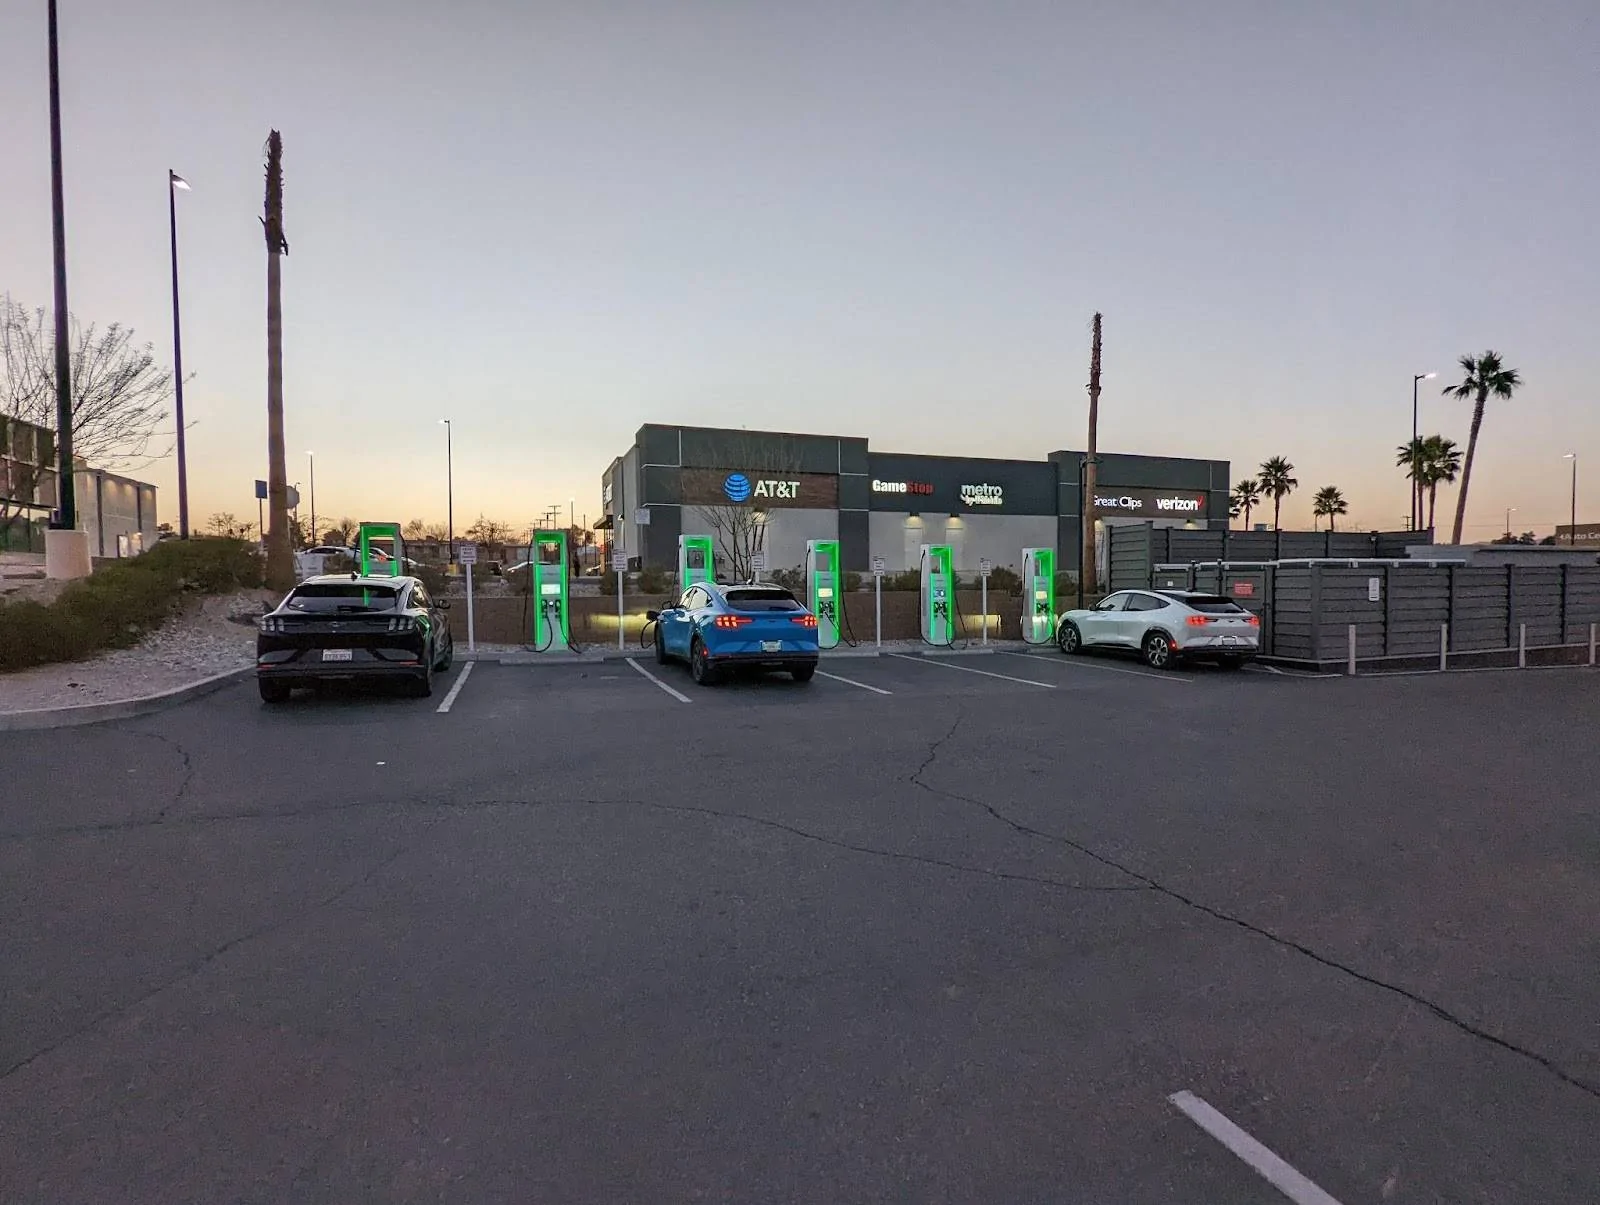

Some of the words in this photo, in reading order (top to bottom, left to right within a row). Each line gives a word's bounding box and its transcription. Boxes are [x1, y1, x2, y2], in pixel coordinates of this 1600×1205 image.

[753, 480, 800, 498] AT&T
[872, 479, 934, 494] GameStop
[961, 483, 1003, 496] metro
[1119, 496, 1142, 510] Clips
[1156, 497, 1198, 510] verizon
